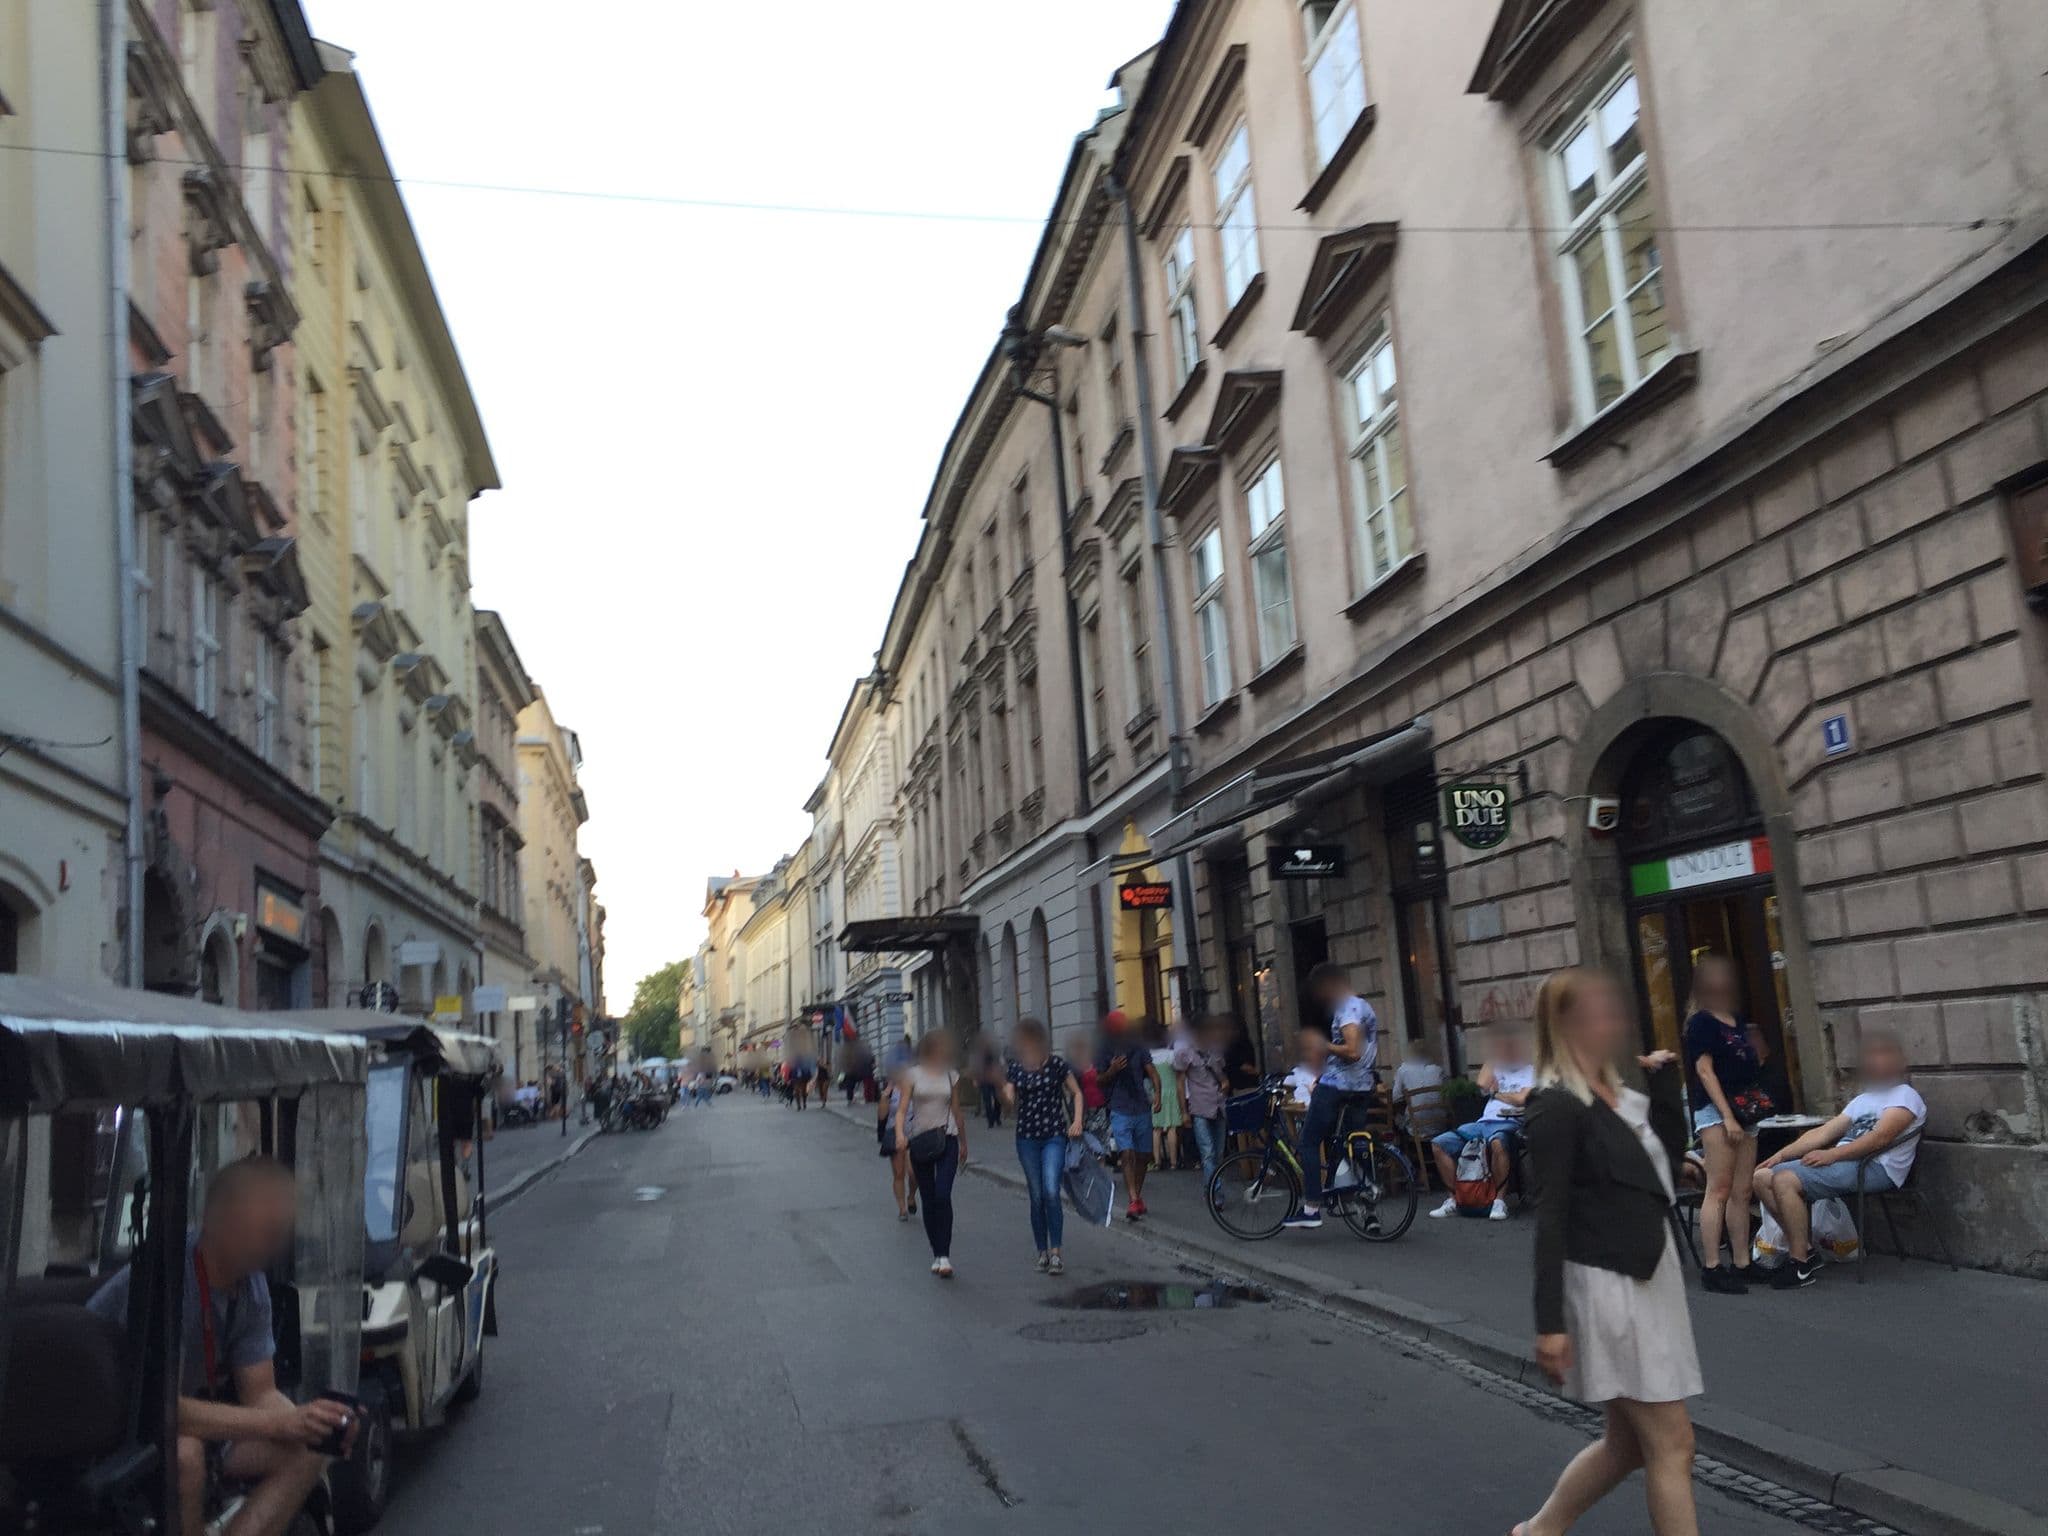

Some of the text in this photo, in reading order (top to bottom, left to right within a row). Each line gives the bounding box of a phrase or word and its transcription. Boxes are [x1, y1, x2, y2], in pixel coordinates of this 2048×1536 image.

[1828, 720, 1842, 743] 1
[1453, 789, 1505, 808] UNO
[1455, 807, 1506, 826] DUE
